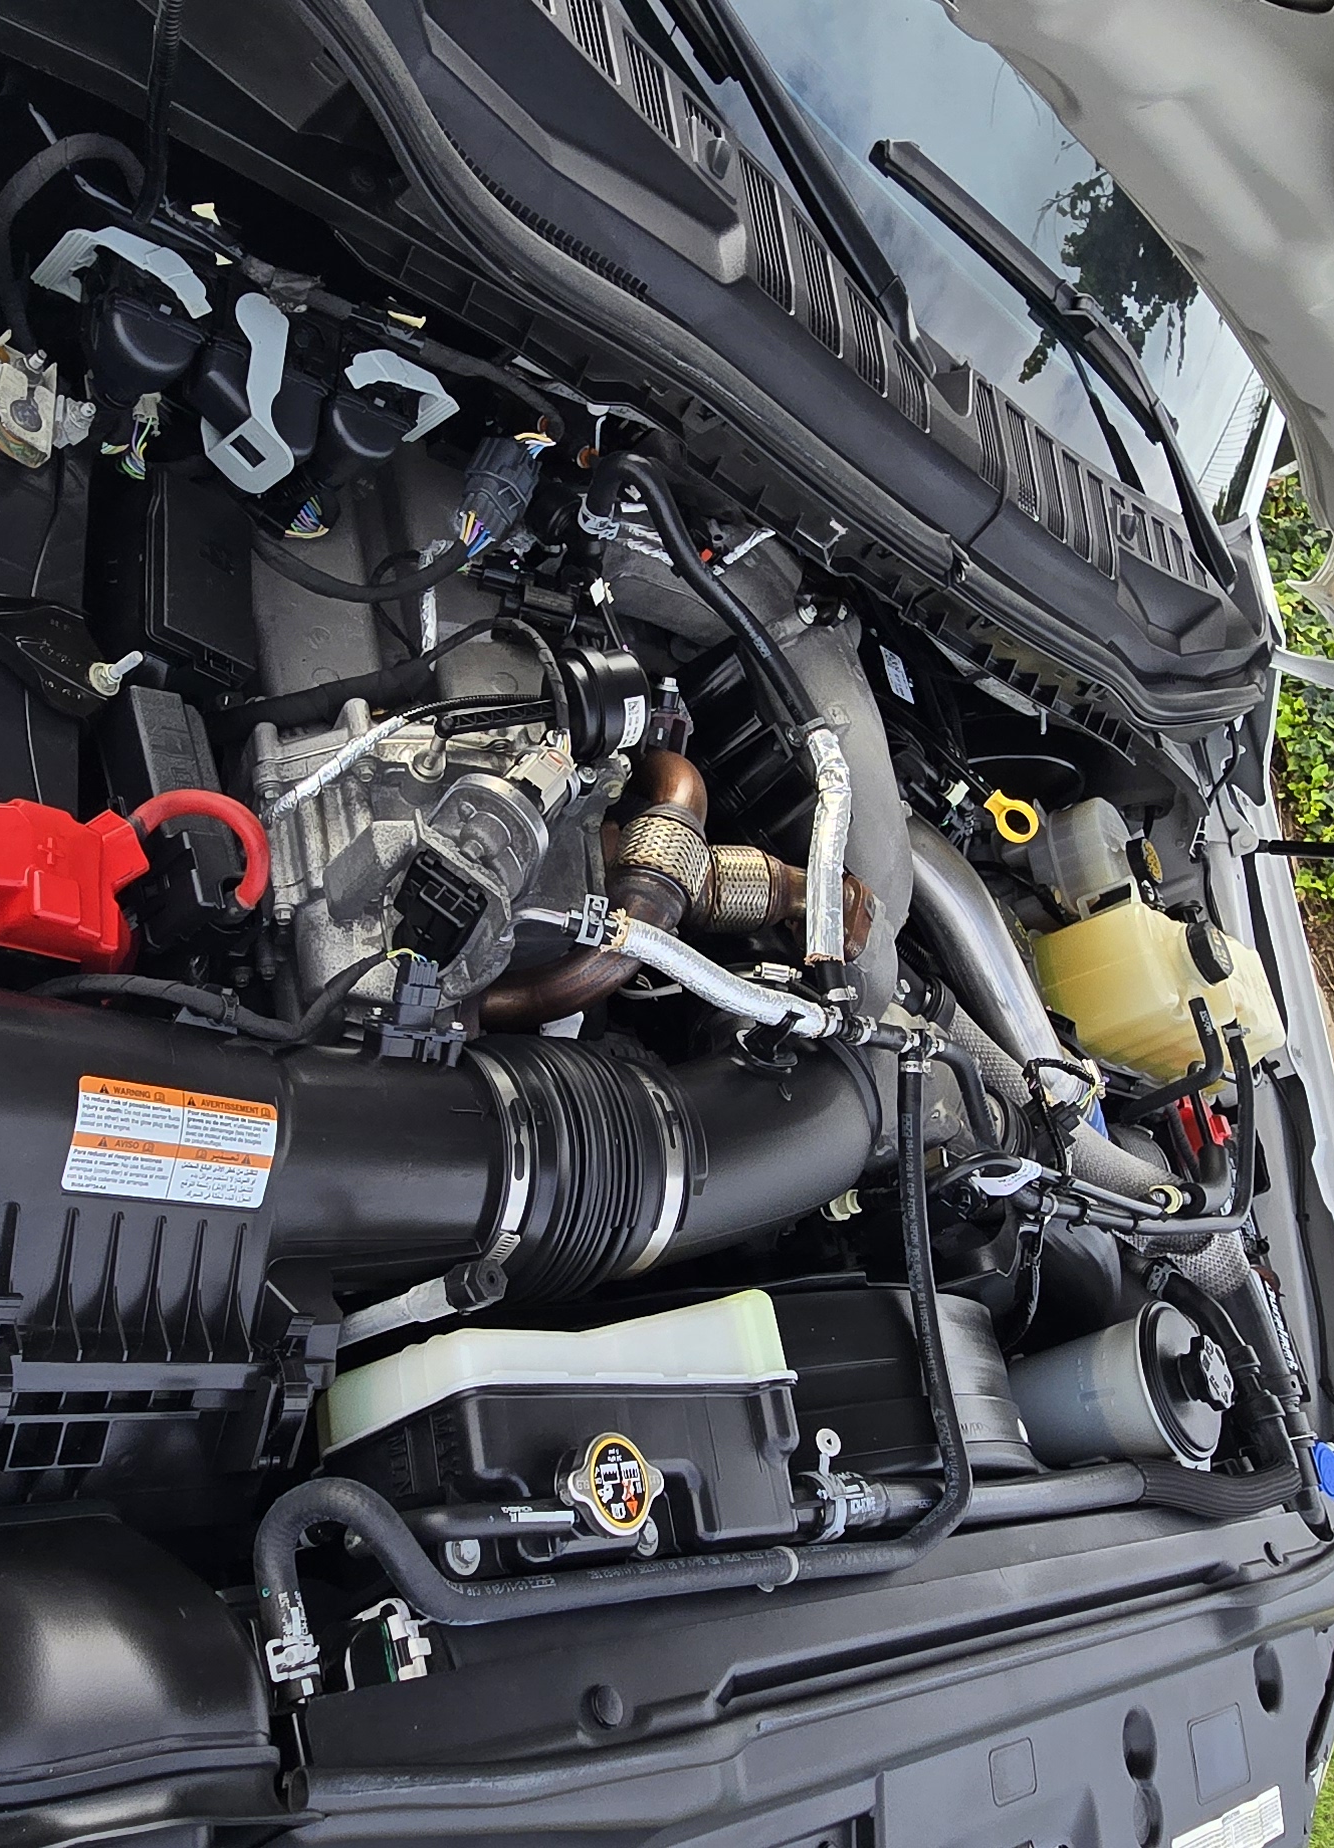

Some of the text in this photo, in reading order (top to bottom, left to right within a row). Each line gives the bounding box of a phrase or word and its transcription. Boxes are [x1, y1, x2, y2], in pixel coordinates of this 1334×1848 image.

[113, 1086, 151, 1099] WARNING
[128, 1102, 150, 1110] possible
[201, 1099, 258, 1114] AVERTISSEMENT
[114, 1140, 140, 1149] AVISO
